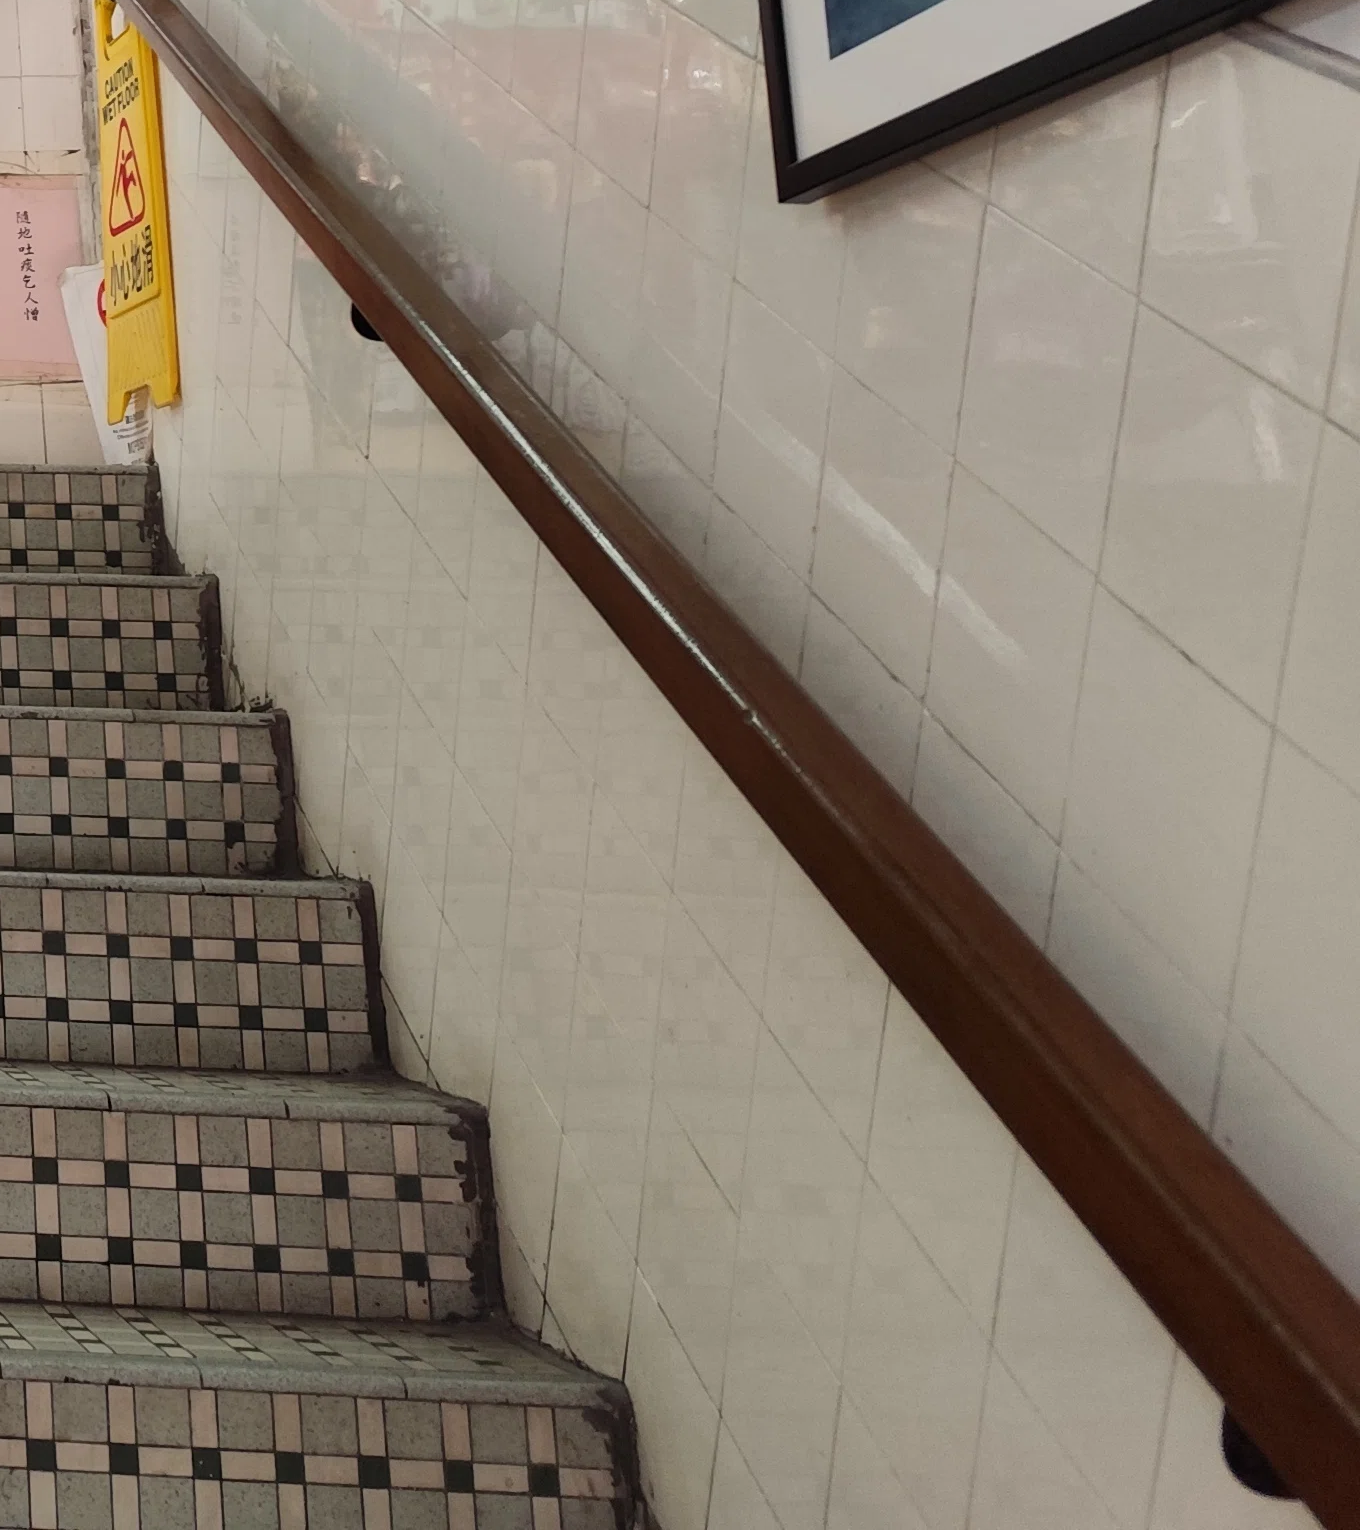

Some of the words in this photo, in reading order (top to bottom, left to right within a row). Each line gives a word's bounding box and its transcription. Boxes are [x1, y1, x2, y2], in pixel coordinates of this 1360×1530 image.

[102, 91, 117, 126] WET
[116, 77, 140, 114] FLOOR
[104, 57, 134, 99] CAUTION
[16, 210, 39, 321] 隨地吐痰乞人憎
[110, 225, 155, 307] 小心地滑
